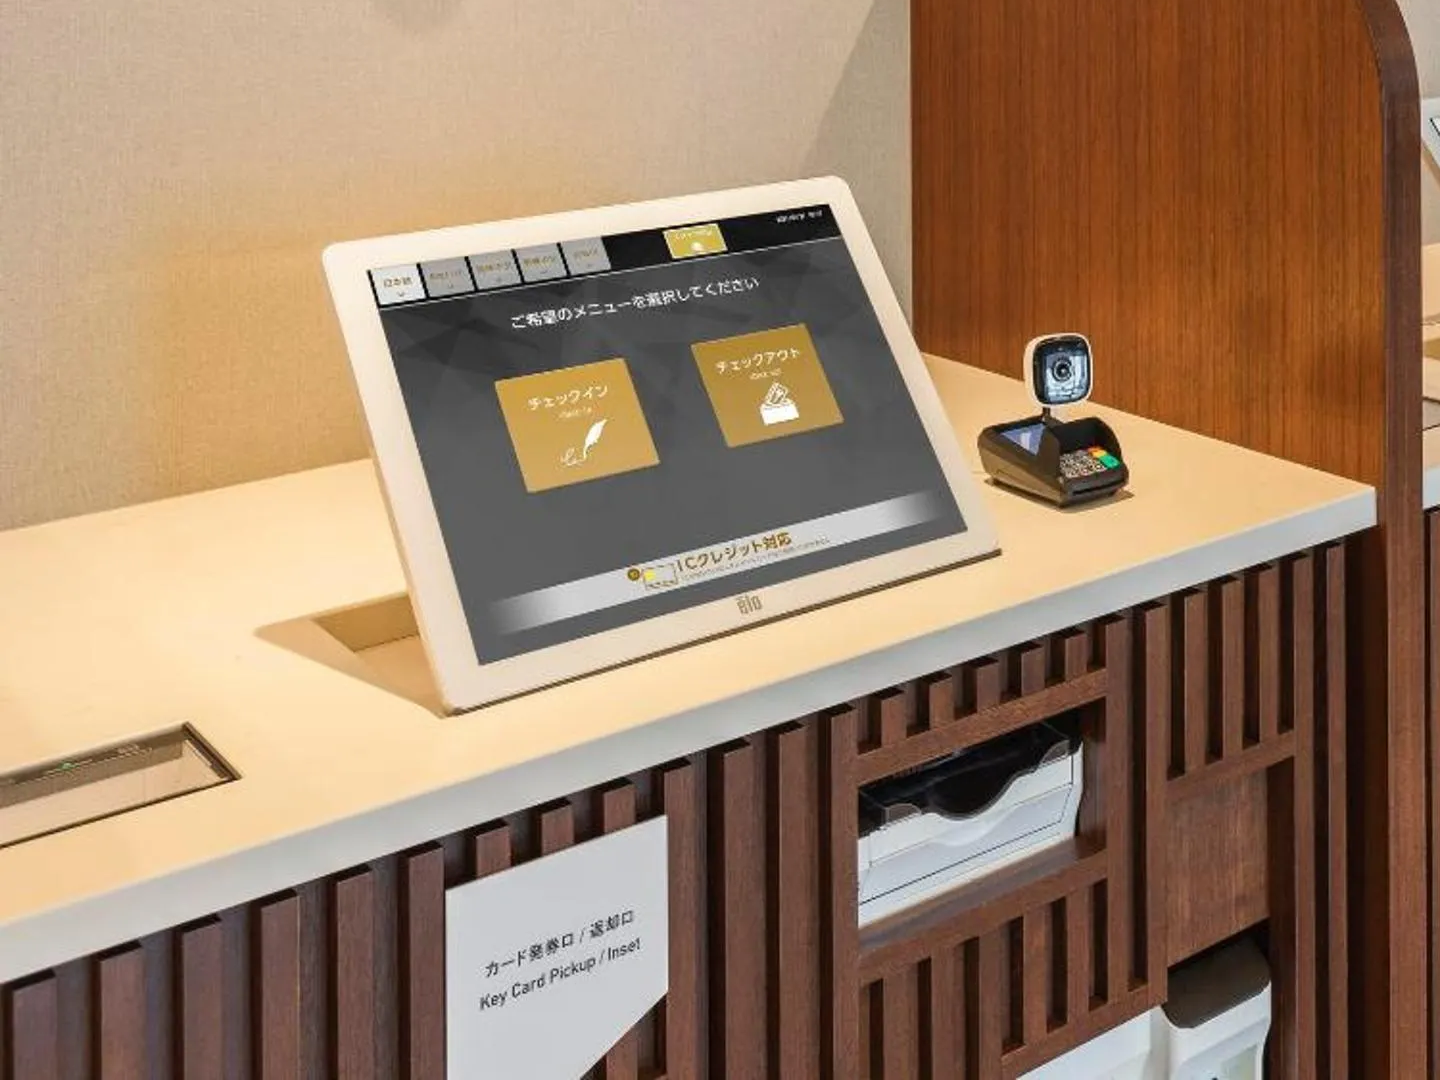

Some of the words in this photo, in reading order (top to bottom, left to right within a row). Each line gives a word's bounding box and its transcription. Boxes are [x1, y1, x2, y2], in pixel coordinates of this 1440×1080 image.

[511, 276, 760, 329] ご希望のメニューを選択してください
[715, 346, 801, 375] チェックアウト
[527, 384, 608, 411] チェックイン
[479, 991, 508, 1011] Key
[511, 973, 546, 998] Card
[549, 956, 597, 984] Pickup
[607, 937, 642, 961] Inset
